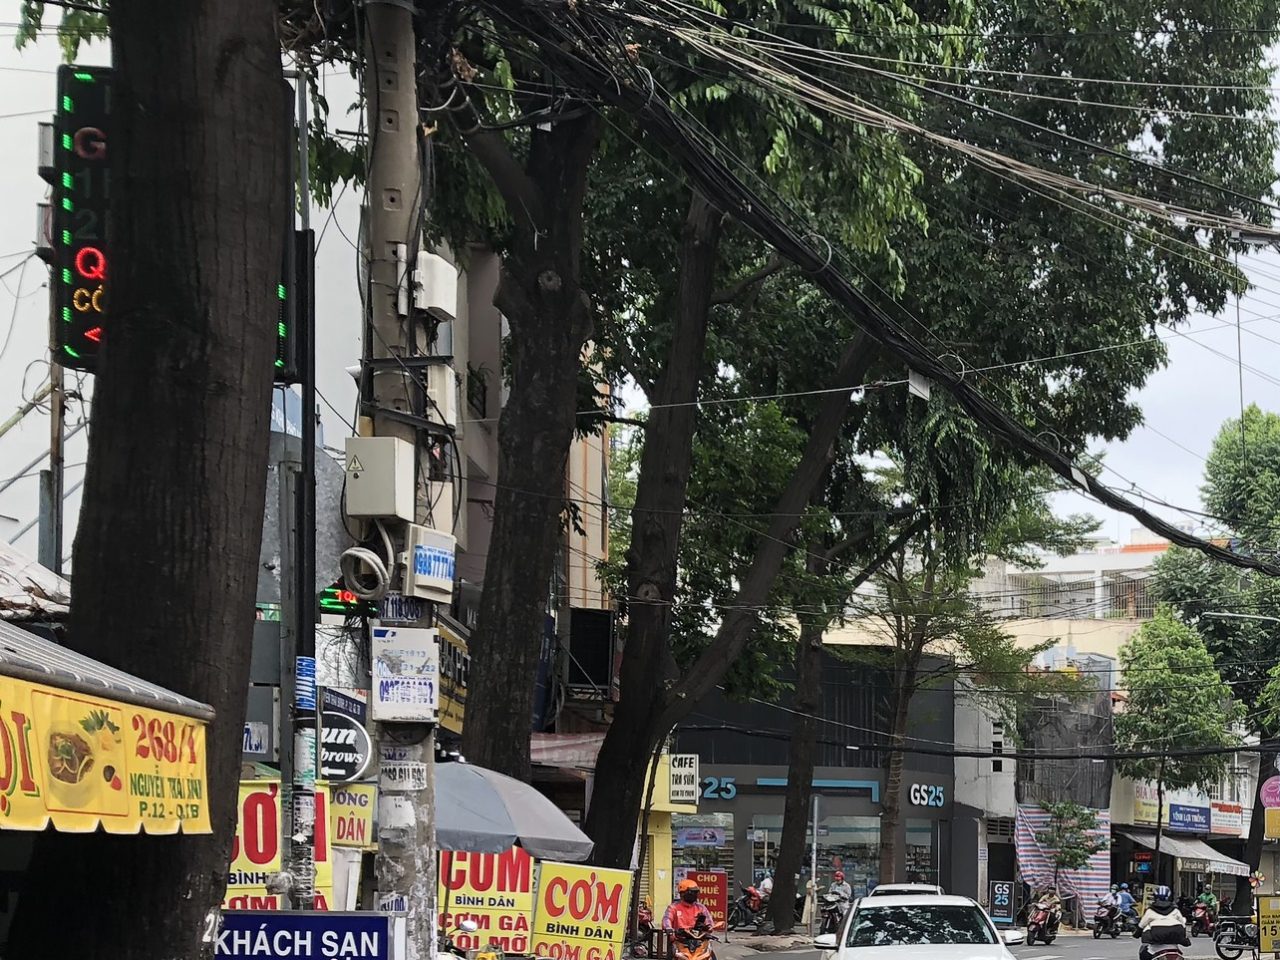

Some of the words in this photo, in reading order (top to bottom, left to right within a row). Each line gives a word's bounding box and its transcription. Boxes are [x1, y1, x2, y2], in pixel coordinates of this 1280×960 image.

[672, 756, 695, 768] CAFE
[910, 783, 945, 807] GS25
[139, 801, 165, 819] P.12
[337, 812, 366, 841] DÂN
[697, 874, 718, 882] CHO
[995, 883, 1010, 894] GS
[455, 895, 484, 906] BÌNH
[488, 895, 515, 908] DÂN
[544, 872, 624, 925] CƠM
[994, 894, 1009, 905] 25
[499, 911, 529, 932] GÀ
[546, 921, 579, 936] BÌNH
[584, 925, 613, 939] DÂN
[214, 923, 312, 956] KHÁCH
[321, 931, 379, 960] SẠN
